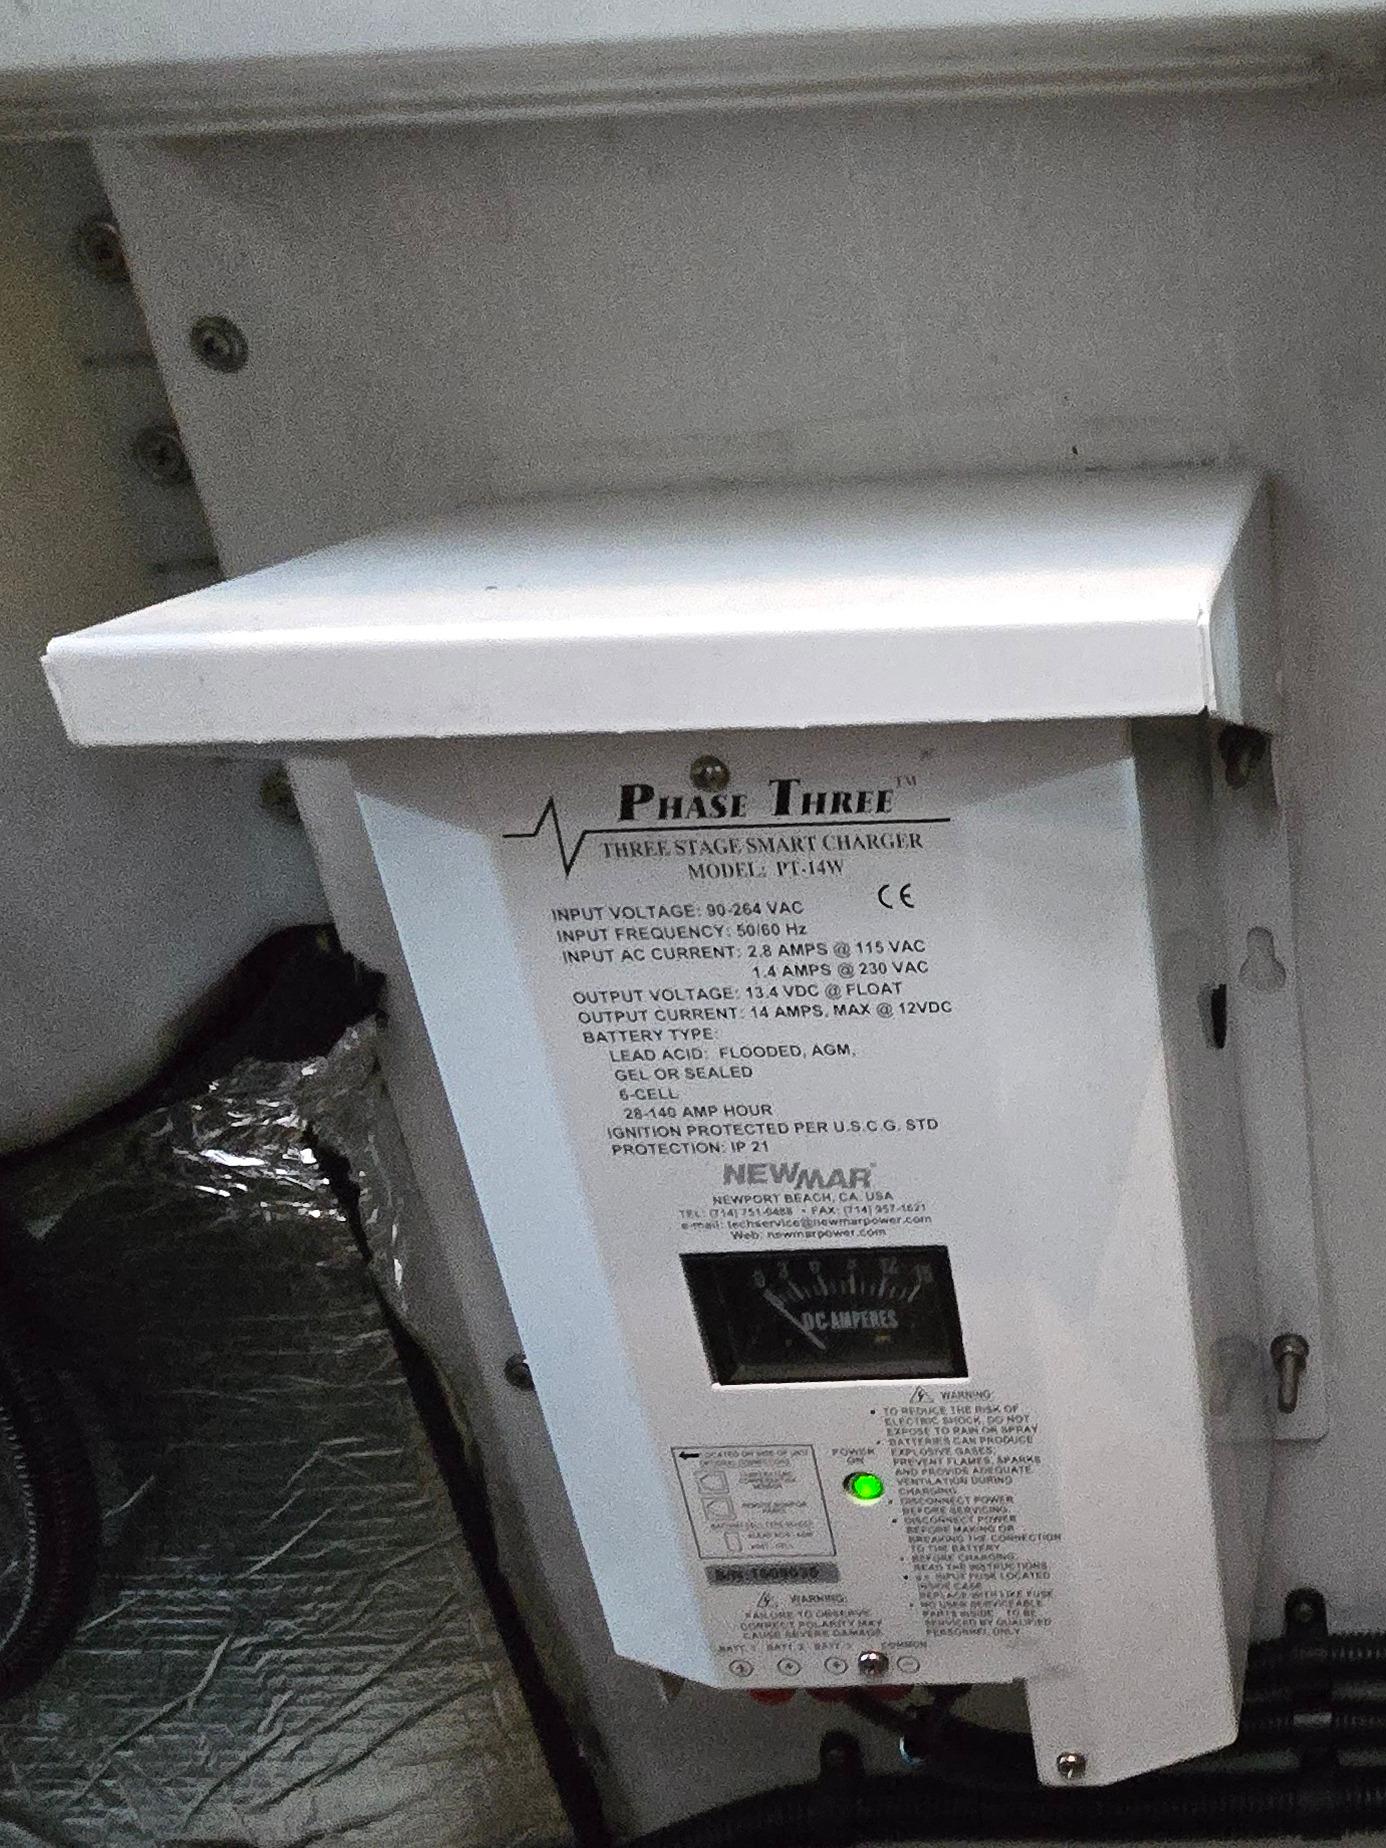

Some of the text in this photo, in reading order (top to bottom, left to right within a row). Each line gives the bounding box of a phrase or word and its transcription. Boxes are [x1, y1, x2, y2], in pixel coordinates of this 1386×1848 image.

[618, 778, 894, 822] PHASE THREE
[601, 832, 923, 860] THREE STAGE SMART CHARGER
[687, 858, 845, 880] MODEL: PT-14W
[551, 901, 804, 923] INPUT VOLTAGE: 90-264 VAC
[557, 923, 808, 943] INPUT FREQUENCY: 50/60 Hz
[562, 939, 926, 965] INPUT AC CURRENT: 2.8 AMPS @ 115 VAC
[752, 960, 929, 980] 1.4 AMPS @ 230 VAC
[572, 981, 903, 1005] OUTPUT VOLTAGE: 13.4 VDC @ FLOAT
[578, 1009, 648, 1025] OUTPUT
[654, 1006, 746, 1022] CURRENT:
[750, 1005, 769, 1019] 14
[833, 1003, 872, 1017] MAX
[876, 1002, 894, 1019] @
[898, 1000, 953, 1015] 12VDC
[582, 1027, 719, 1044] BATTERY TYPE:
[609, 1048, 656, 1063] LEAD
[662, 1047, 710, 1061] ACID:
[718, 1044, 807, 1060] FLOODED,
[614, 1065, 754, 1082] GEL OR SEALED
[618, 1087, 678, 1102] 6-CELL
[623, 1103, 773, 1120] 28-140 AMP HOUR
[607, 1125, 682, 1141] IGNITION
[686, 1121, 791, 1138] PROTECTED
[794, 1120, 829, 1135] PER
[905, 1117, 940, 1131] STD
[611, 1139, 770, 1156] PROTECTION: IP 21
[722, 1162, 873, 1191] NEWMAR
[712, 1193, 780, 1207] NEWPORT
[865, 1190, 894, 1202] USA
[801, 1308, 900, 1332] DC AMPERES
[941, 1389, 994, 1400] WARNING
[950, 1404, 972, 1414] THE
[1004, 1403, 1018, 1413] OF
[1007, 1414, 1030, 1424] NOT
[935, 1425, 950, 1435] TO
[953, 1436, 976, 1445] CAN
